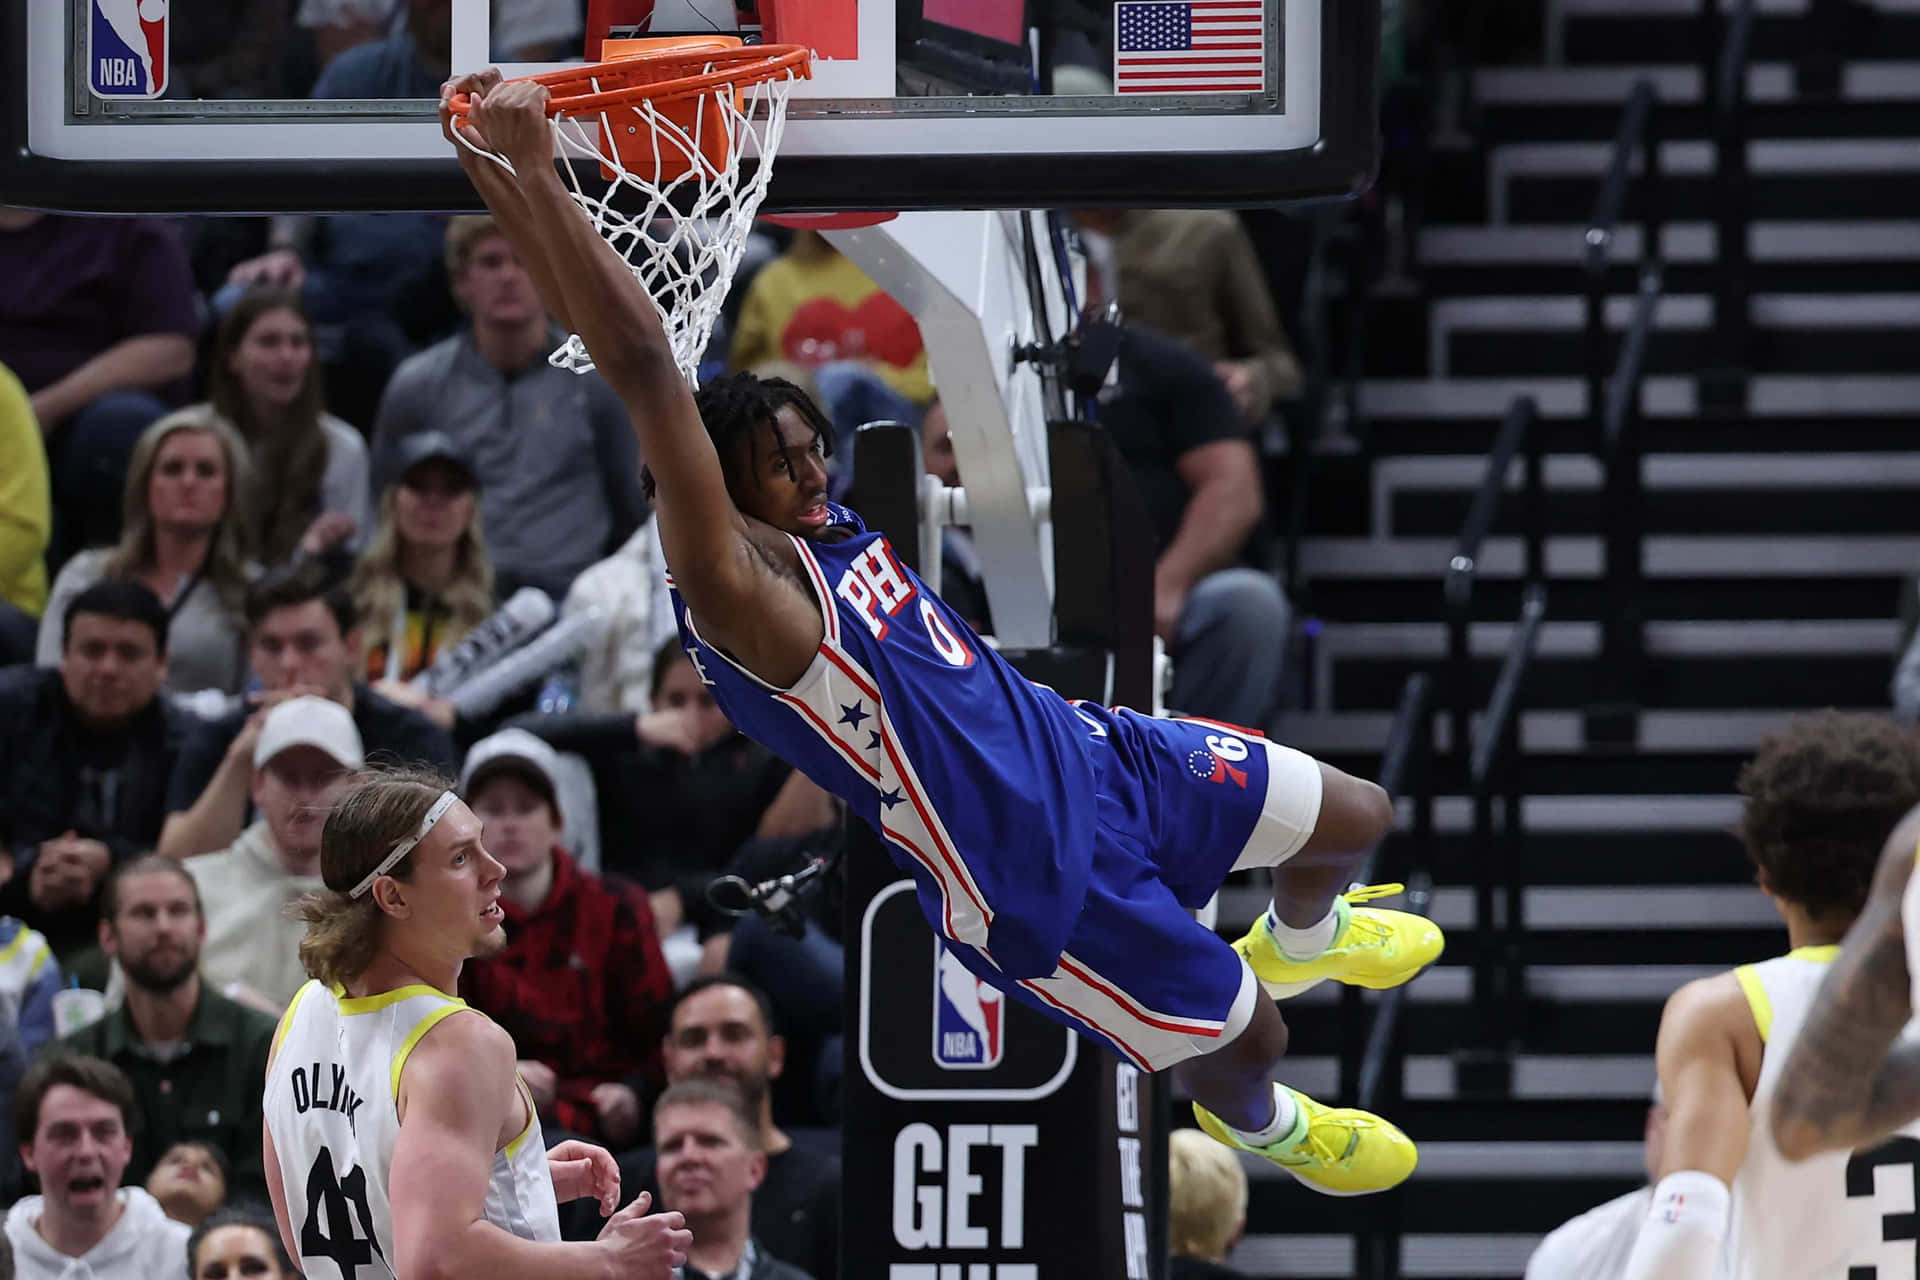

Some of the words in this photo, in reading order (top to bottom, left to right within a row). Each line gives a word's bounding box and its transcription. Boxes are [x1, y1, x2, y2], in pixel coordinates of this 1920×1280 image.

[100, 58, 137, 86] NBA
[919, 597, 975, 667] 0
[943, 1031, 978, 1058] NBA
[892, 1122, 1039, 1250] GET
